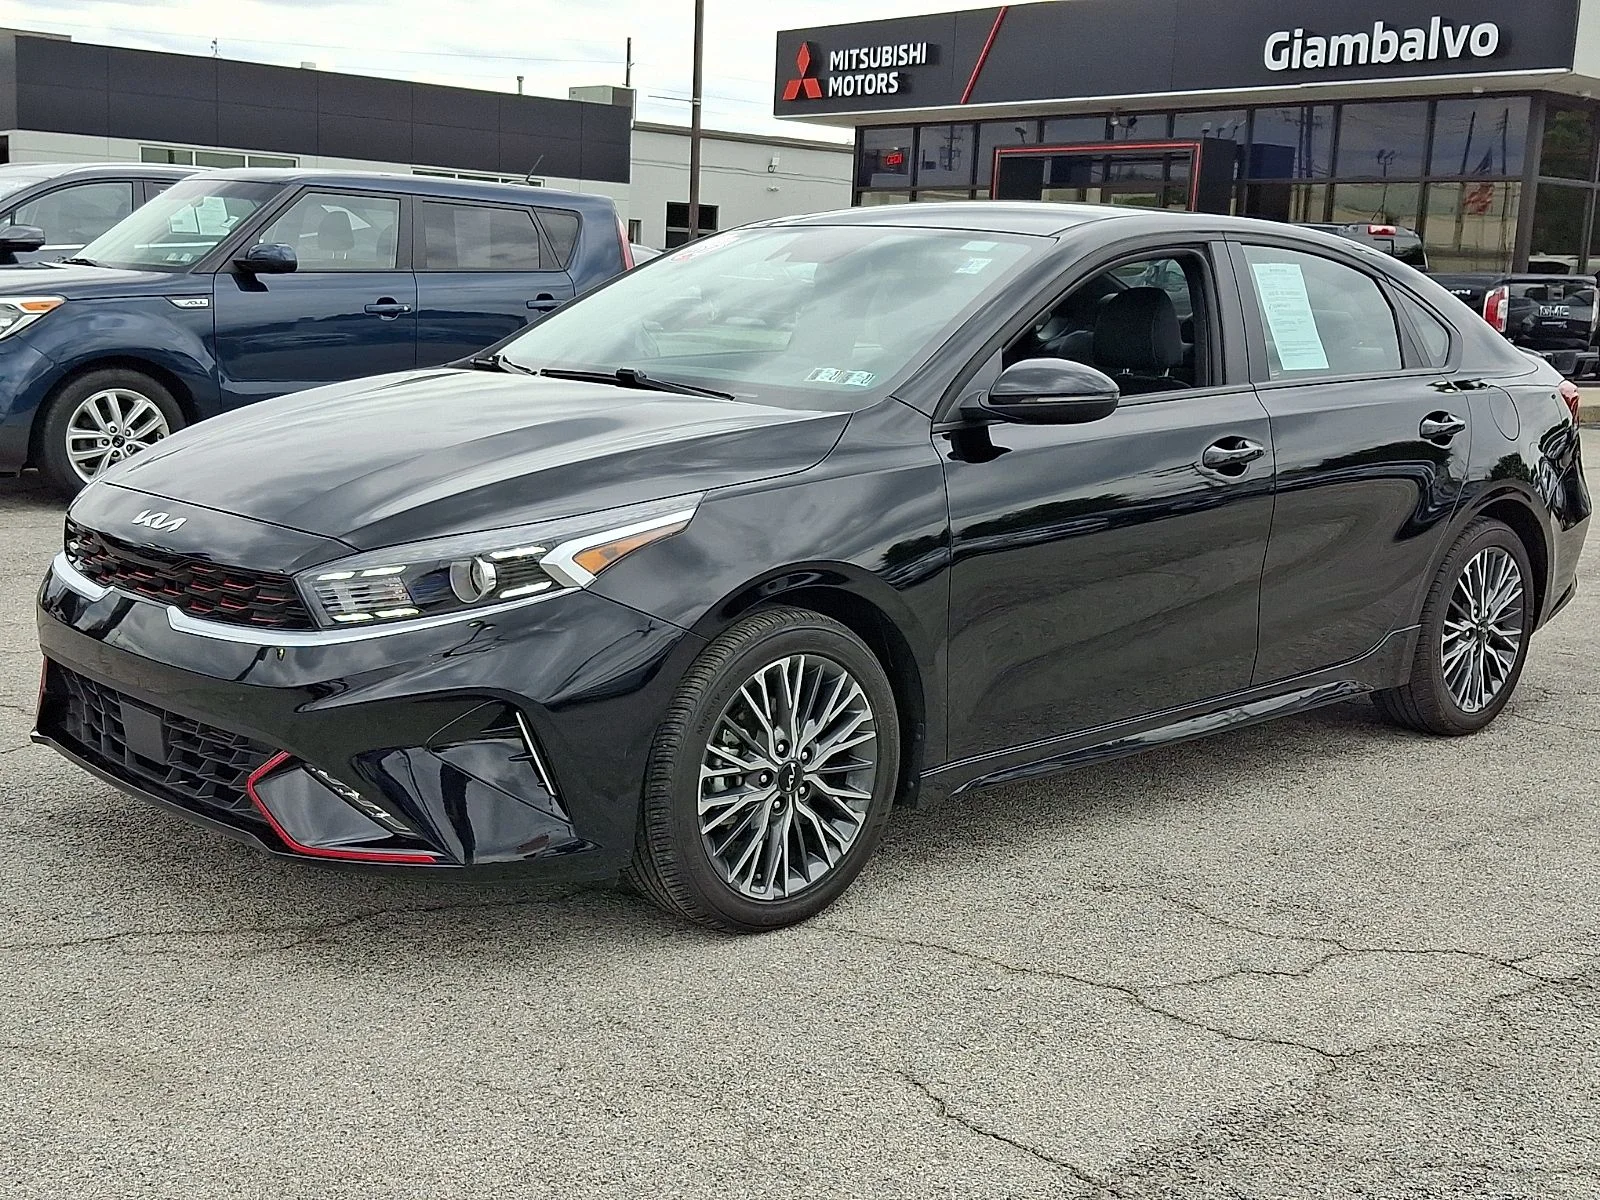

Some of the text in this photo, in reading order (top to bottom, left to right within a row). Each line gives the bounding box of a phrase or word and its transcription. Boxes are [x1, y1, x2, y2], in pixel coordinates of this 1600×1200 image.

[1264, 16, 1499, 71] Giambalvo
[829, 42, 927, 72] MITSUBISHI
[828, 72, 899, 98] MOTORS
[1539, 305, 1570, 317] GMC
[131, 509, 188, 534] KIA
